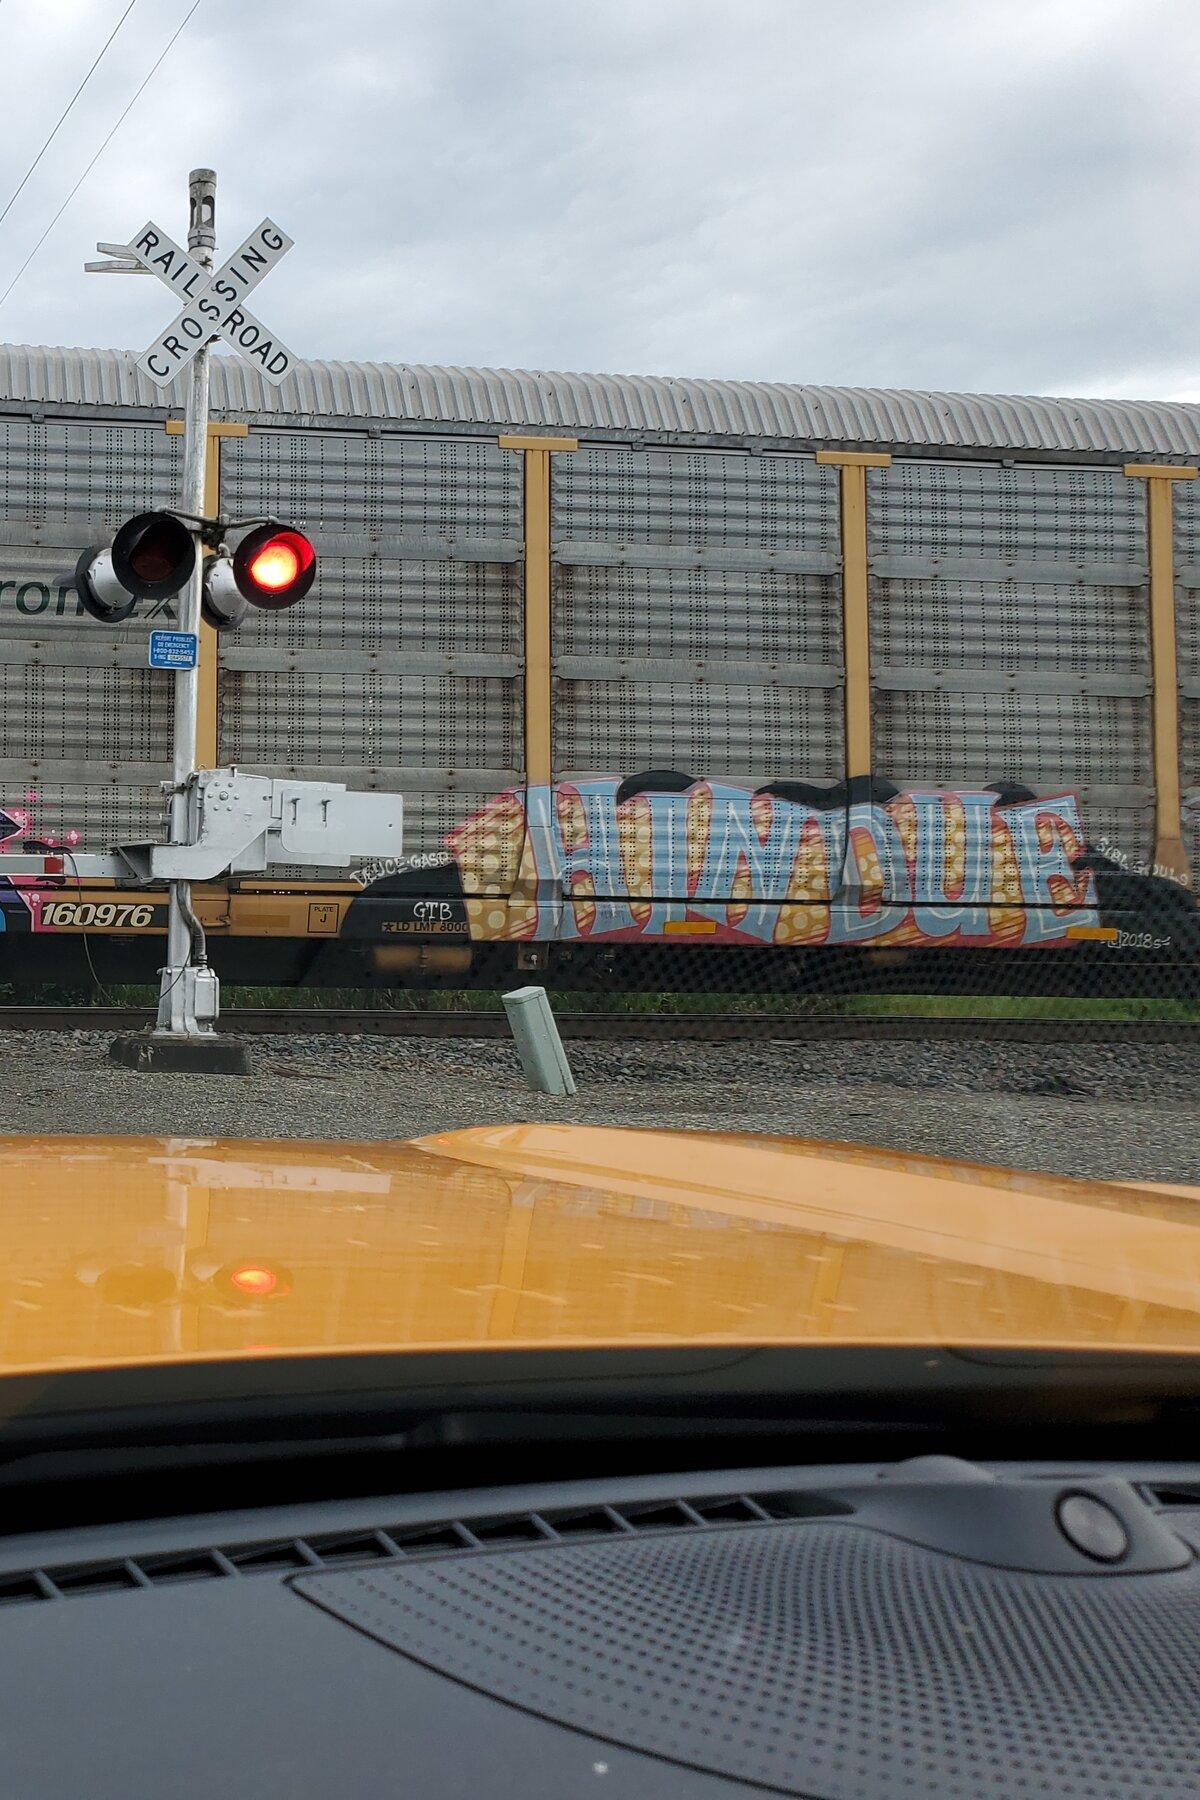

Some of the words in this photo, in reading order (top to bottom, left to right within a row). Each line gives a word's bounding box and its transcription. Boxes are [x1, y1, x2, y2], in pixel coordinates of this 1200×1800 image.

[146, 228, 284, 377] CROSSING
[41, 903, 155, 927] 160976
[319, 914, 328, 923] J
[413, 901, 453, 922] GTB
[1121, 931, 1152, 949] 2018
